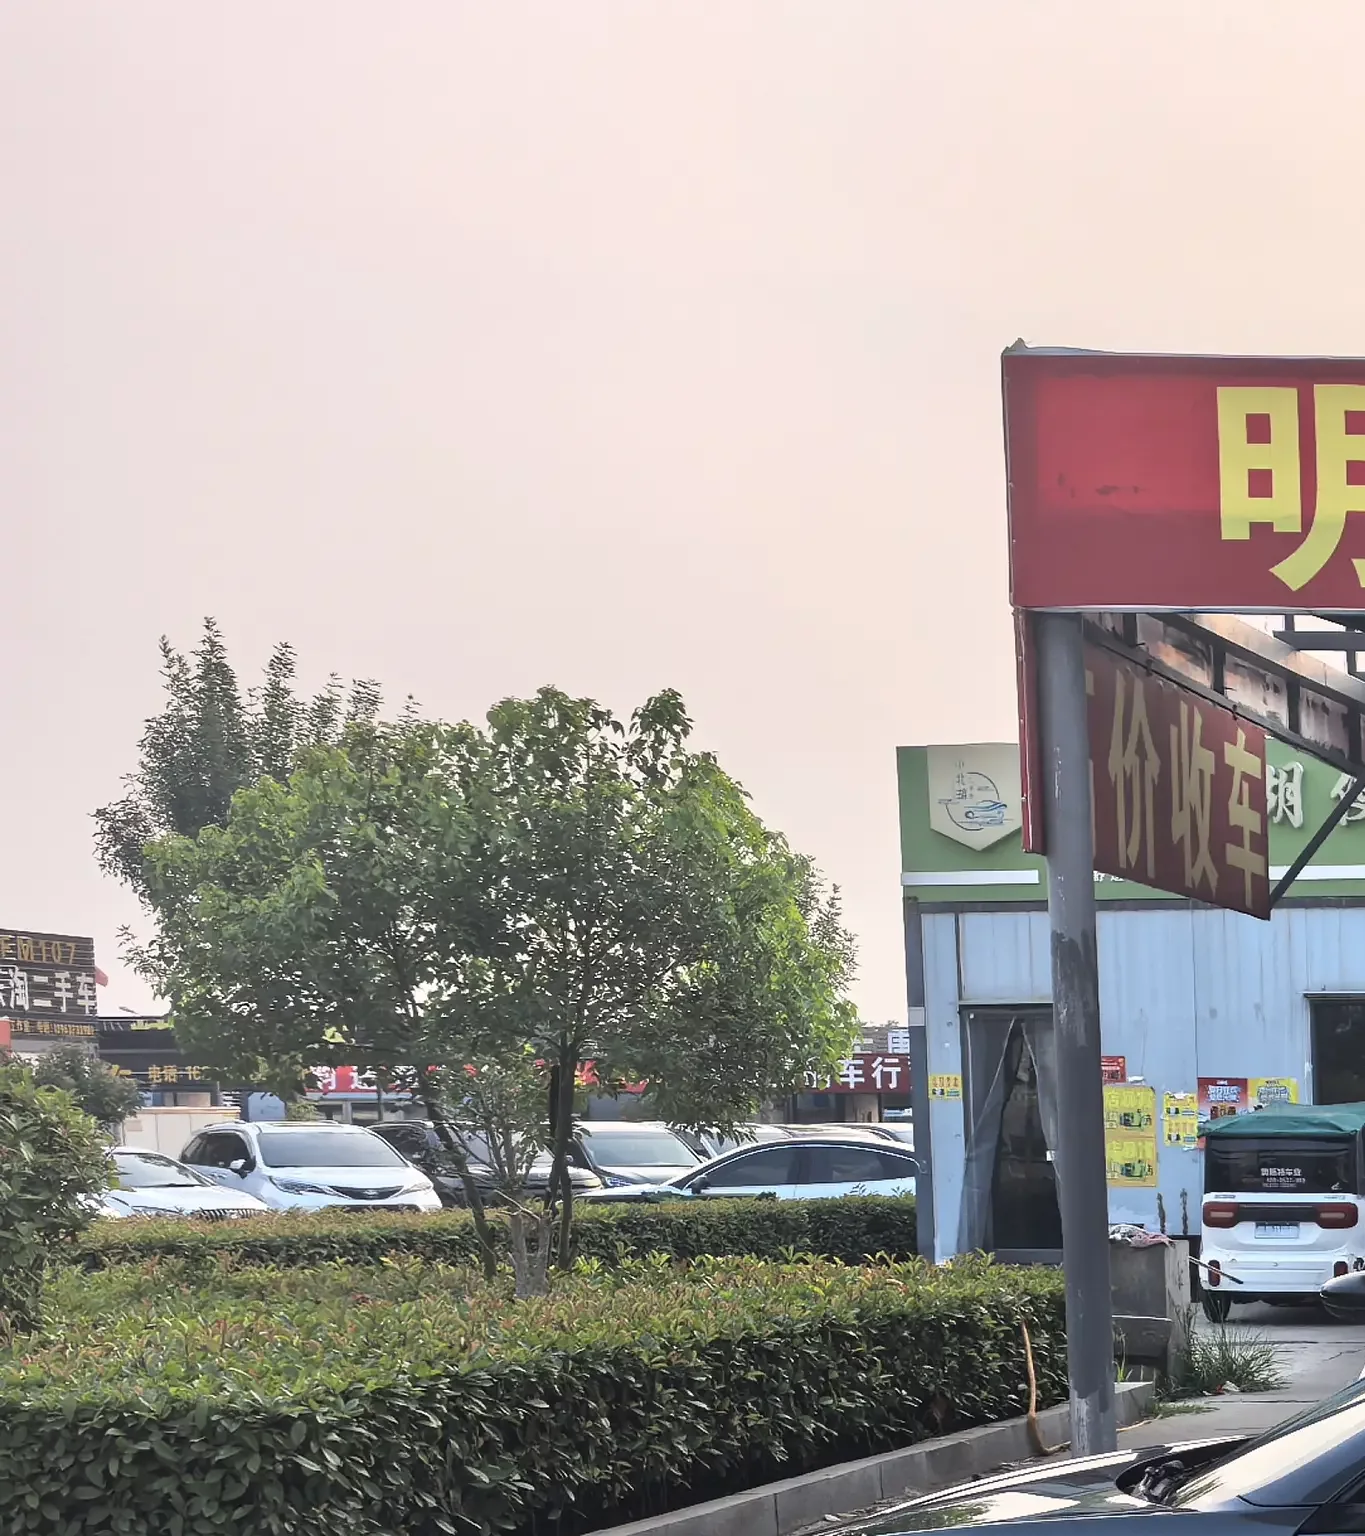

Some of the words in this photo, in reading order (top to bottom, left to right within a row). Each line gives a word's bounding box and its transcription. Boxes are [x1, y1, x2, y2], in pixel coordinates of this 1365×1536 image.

[1087, 669, 1269, 909] 价收车
[0, 965, 97, 1014] 二手车
